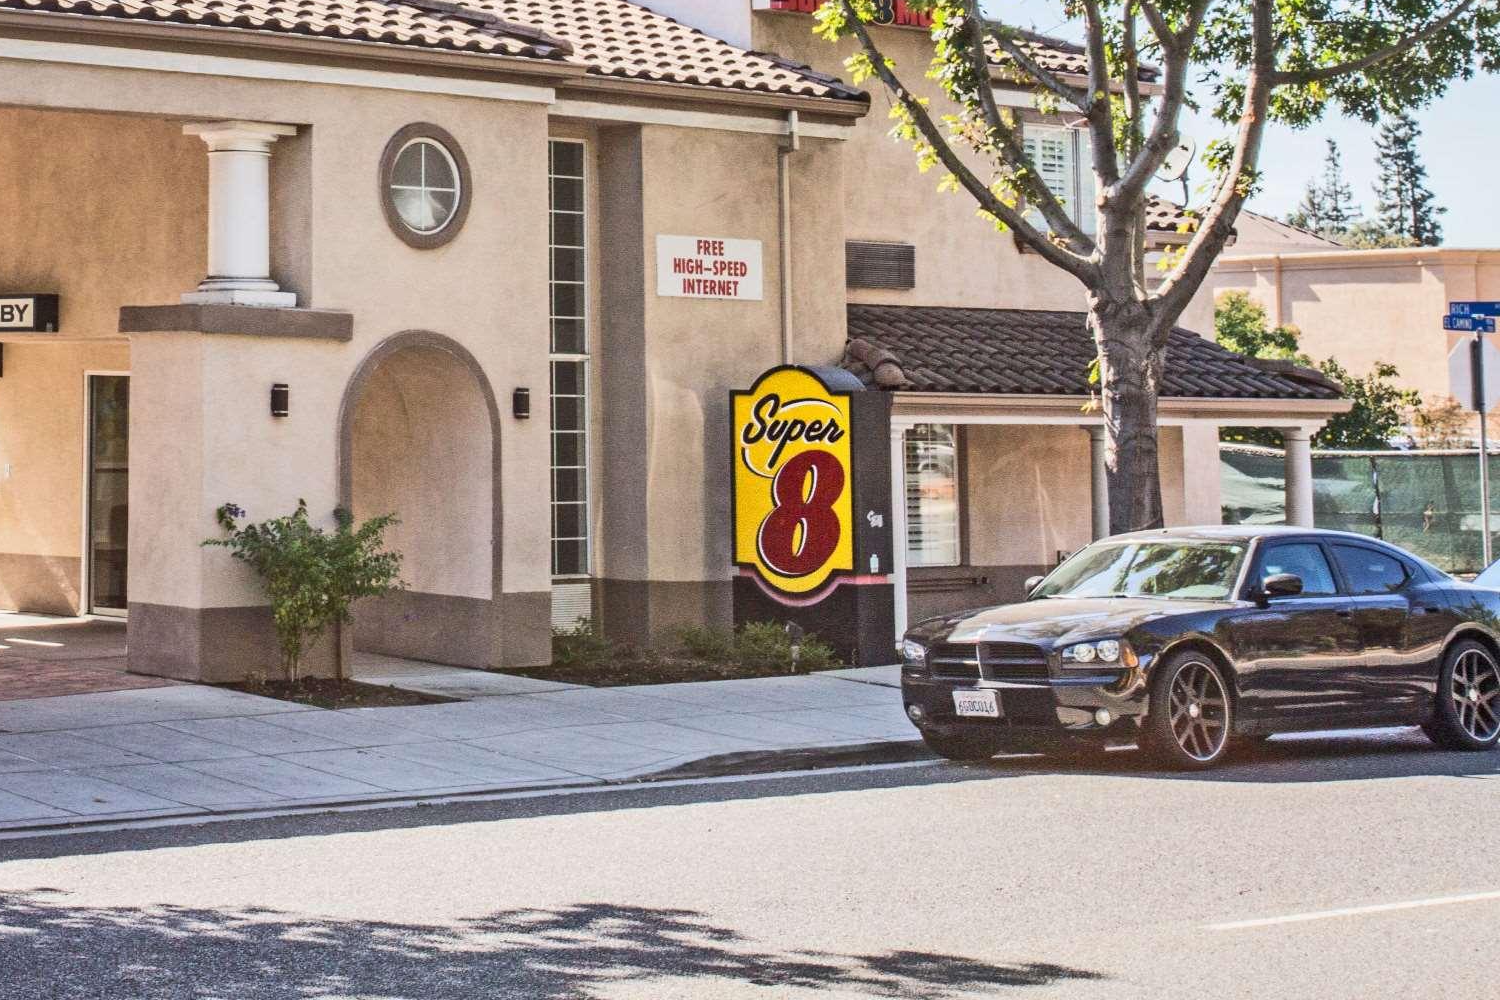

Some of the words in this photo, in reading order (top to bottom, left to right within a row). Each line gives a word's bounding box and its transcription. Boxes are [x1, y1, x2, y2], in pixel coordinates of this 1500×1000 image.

[696, 239, 724, 256] FREE
[673, 258, 747, 277] HIGH-SPEED
[682, 278, 739, 296] INTERNET
[1451, 303, 1470, 314] RICH
[742, 393, 845, 470] Super
[757, 450, 845, 577] 8
